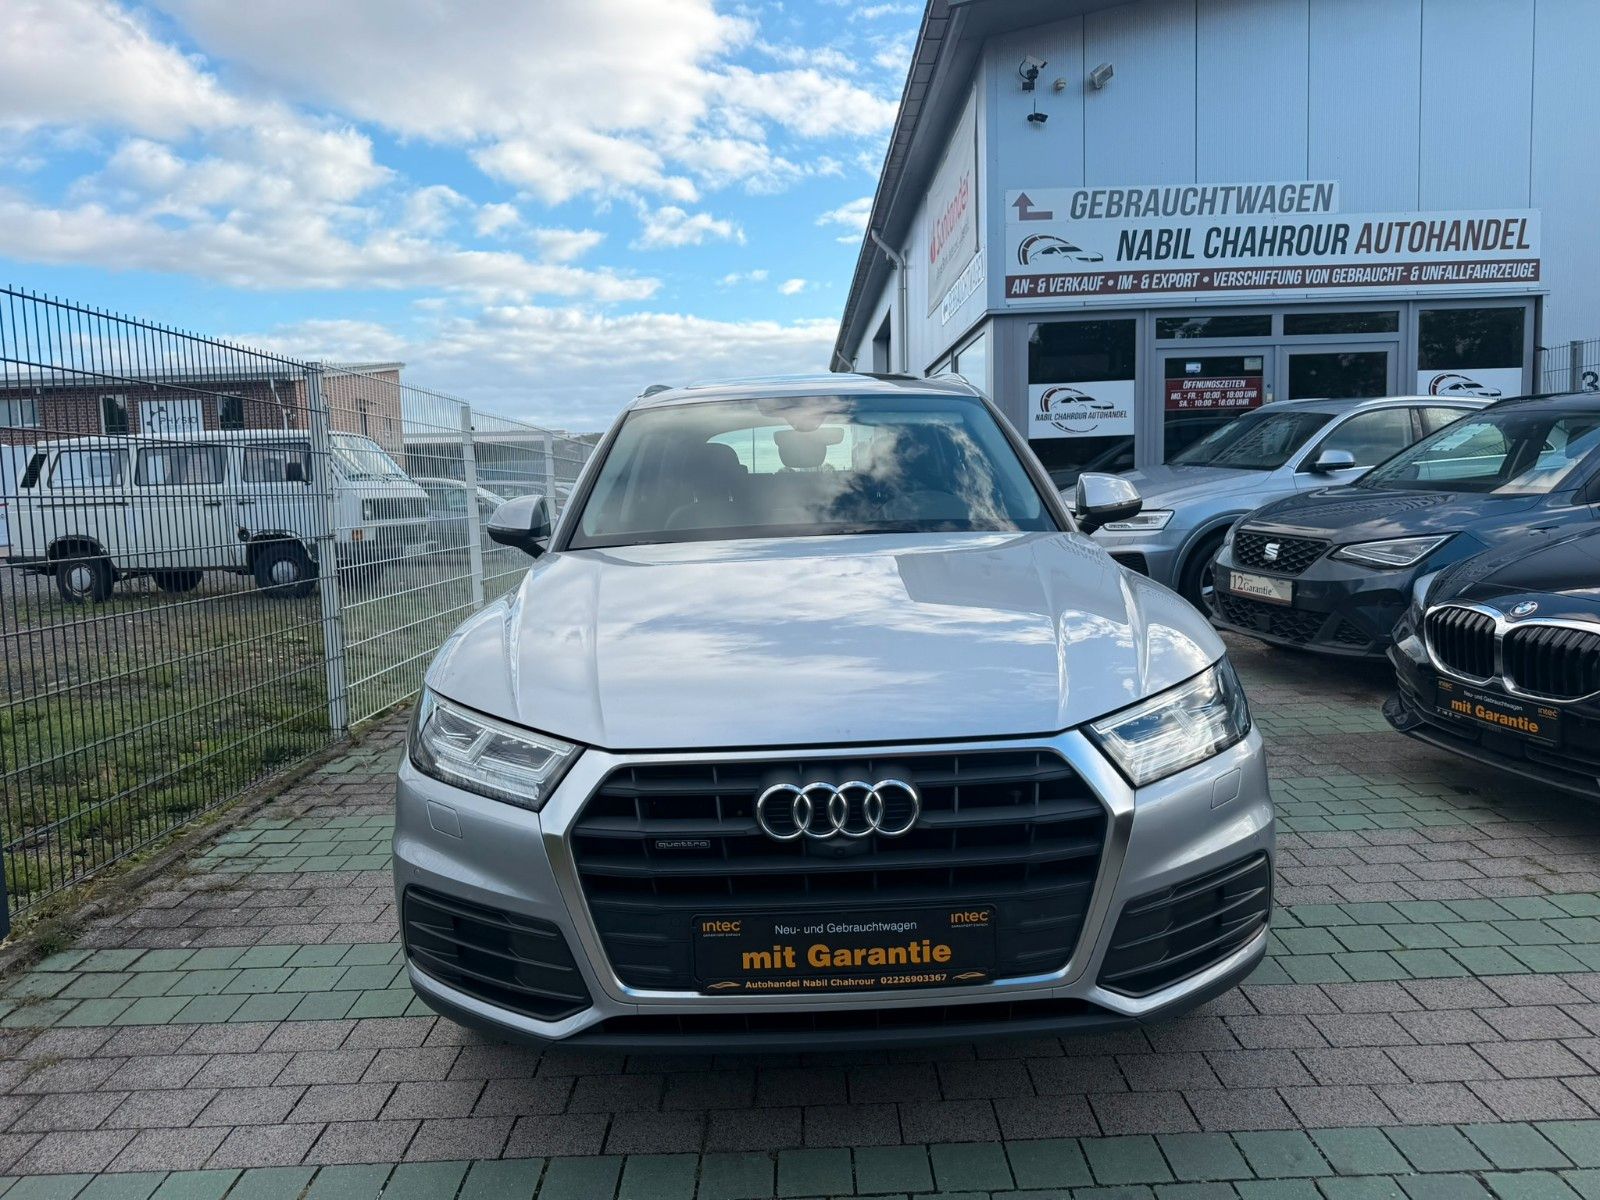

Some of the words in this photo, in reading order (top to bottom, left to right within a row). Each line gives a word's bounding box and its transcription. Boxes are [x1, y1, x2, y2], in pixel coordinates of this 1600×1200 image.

[1070, 183, 1334, 219] GEBRAUCHTWAGEN
[1116, 228, 1195, 262] NABIL
[1203, 223, 1351, 259] CHAHROUR
[1354, 218, 1531, 254] AUTOHANDEL
[1011, 278, 1034, 295] AN-
[1037, 278, 1047, 293] &
[1049, 275, 1105, 293] VERKAUF
[1117, 275, 1138, 290] IM-
[1140, 274, 1150, 289] &
[1152, 272, 1200, 288] EXPORT
[1213, 268, 1302, 287] VERSCHIFFUNG
[1305, 269, 1332, 285] VON
[1332, 265, 1407, 283] GEBRAUCHT-
[1410, 265, 1419, 281] &
[1422, 262, 1537, 281] UNFALLFAHRZEUGE
[1183, 379, 1246, 389] ÖFFNUNGSZEITEN
[1035, 413, 1053, 421] NABIL
[1054, 411, 1087, 421] CHAHROUR
[1088, 410, 1128, 420] AUTOHANDEL
[1231, 574, 1244, 590] 12
[1243, 581, 1273, 596] Garantie
[1451, 700, 1472, 714] mit
[1475, 704, 1539, 733] Garantie
[702, 920, 741, 932] intec
[950, 911, 989, 923] intec
[775, 924, 800, 935] Neu-
[803, 924, 823, 934] und
[827, 921, 917, 934] Gebrauchtwagen
[742, 945, 796, 970] mit
[807, 940, 952, 968] Garantie
[745, 979, 800, 989] Autohandel
[803, 978, 828, 988] Nabil
[830, 977, 875, 987] Chahrour
